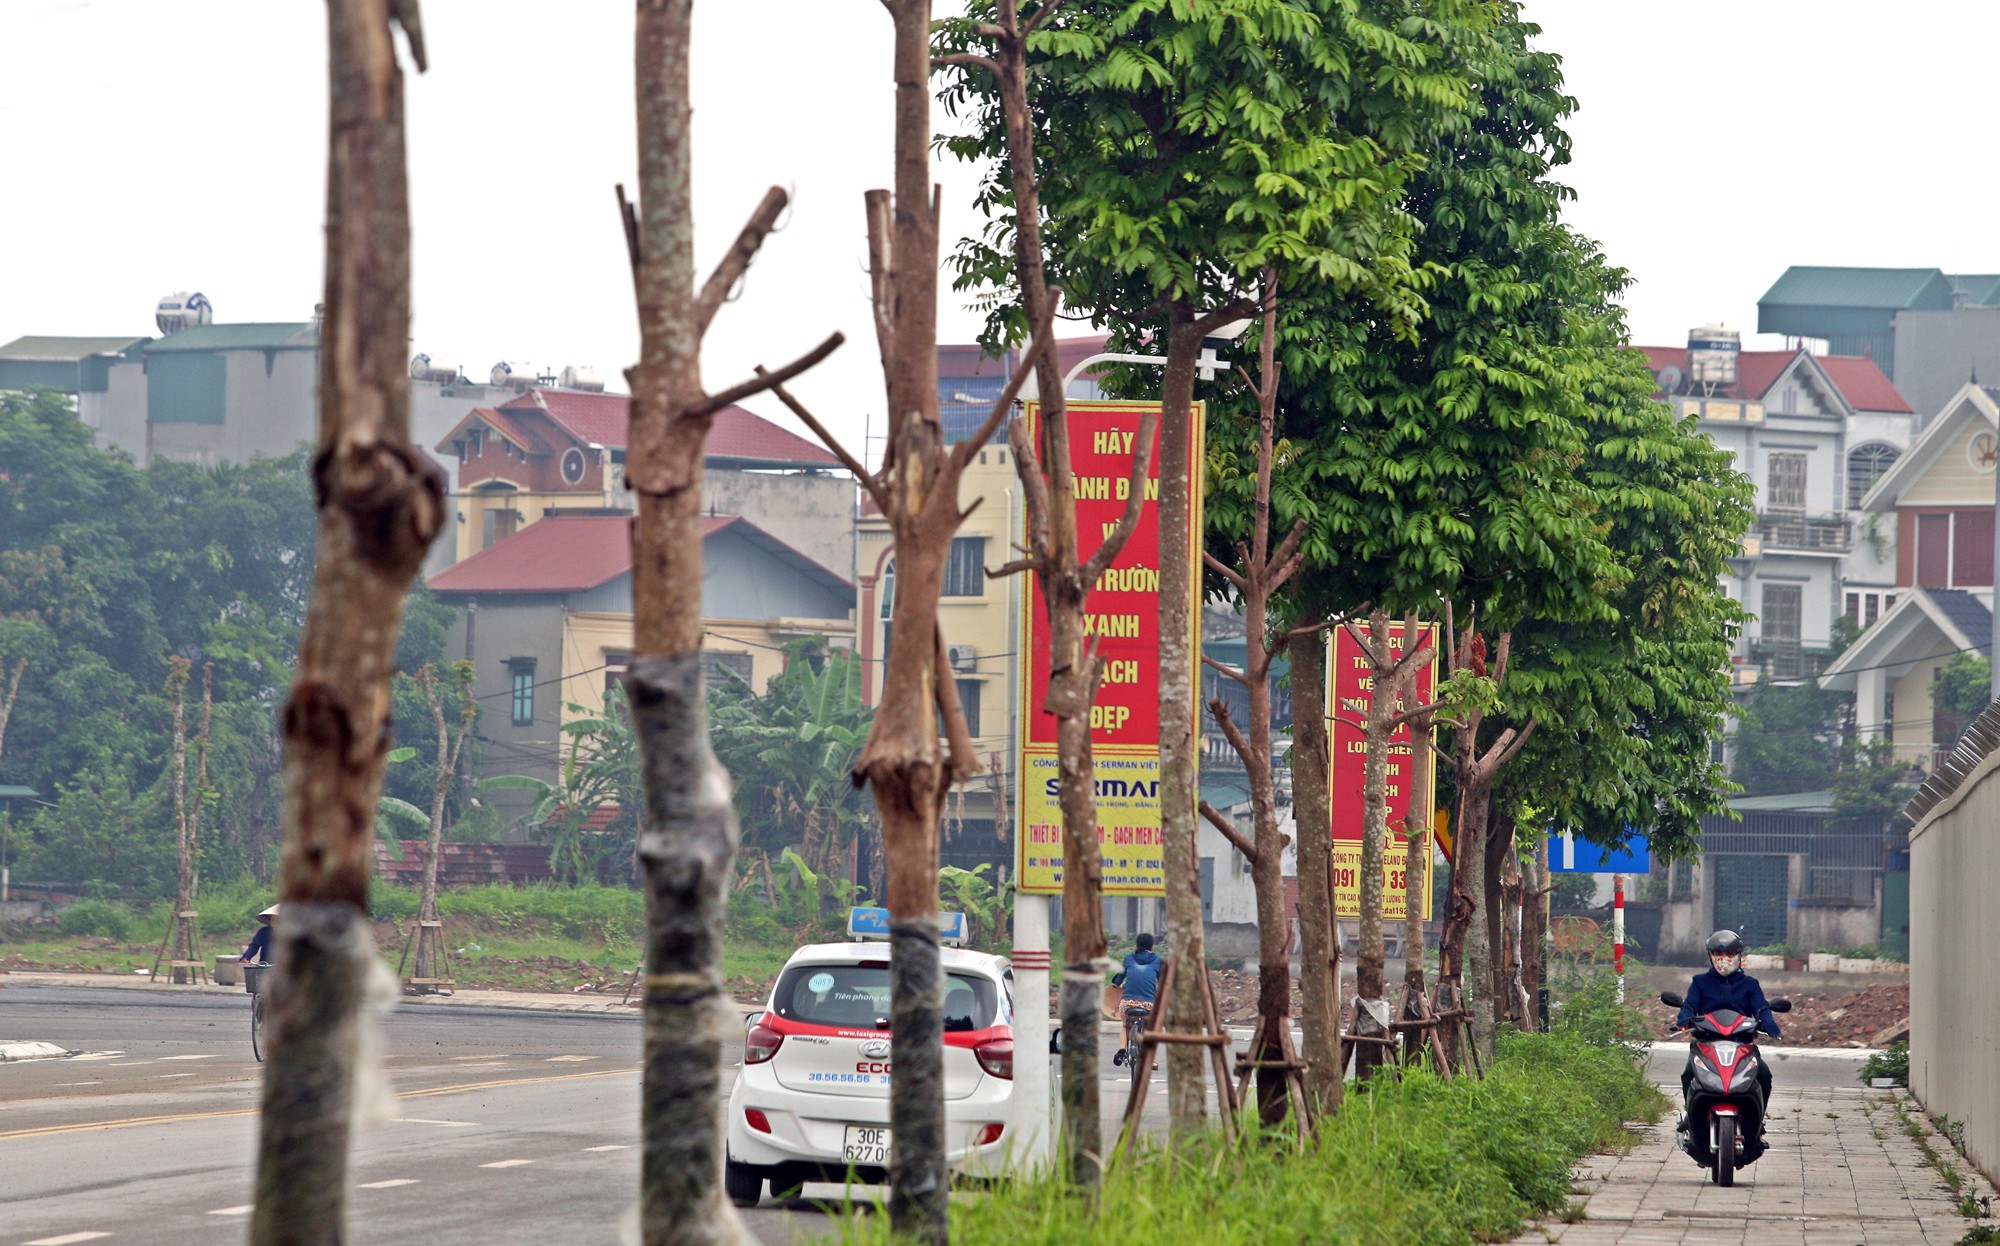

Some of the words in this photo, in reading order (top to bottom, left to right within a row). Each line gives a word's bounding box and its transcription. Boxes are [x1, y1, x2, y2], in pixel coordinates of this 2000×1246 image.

[1094, 427, 1134, 455] HÃY
[1071, 472, 1110, 500] ÀNH
[1115, 477, 1159, 501] ĐN
[1096, 563, 1160, 593] TRƯỜN
[1083, 614, 1140, 638] XANH
[1100, 660, 1139, 689] ẠCH
[1090, 706, 1130, 735] ĐẸP
[1101, 761, 1137, 769] SERMAN
[1384, 855, 1400, 866] ELAND
[838, 1029, 893, 1039] www.taxigroup.
[857, 1128, 885, 1146] 30E
